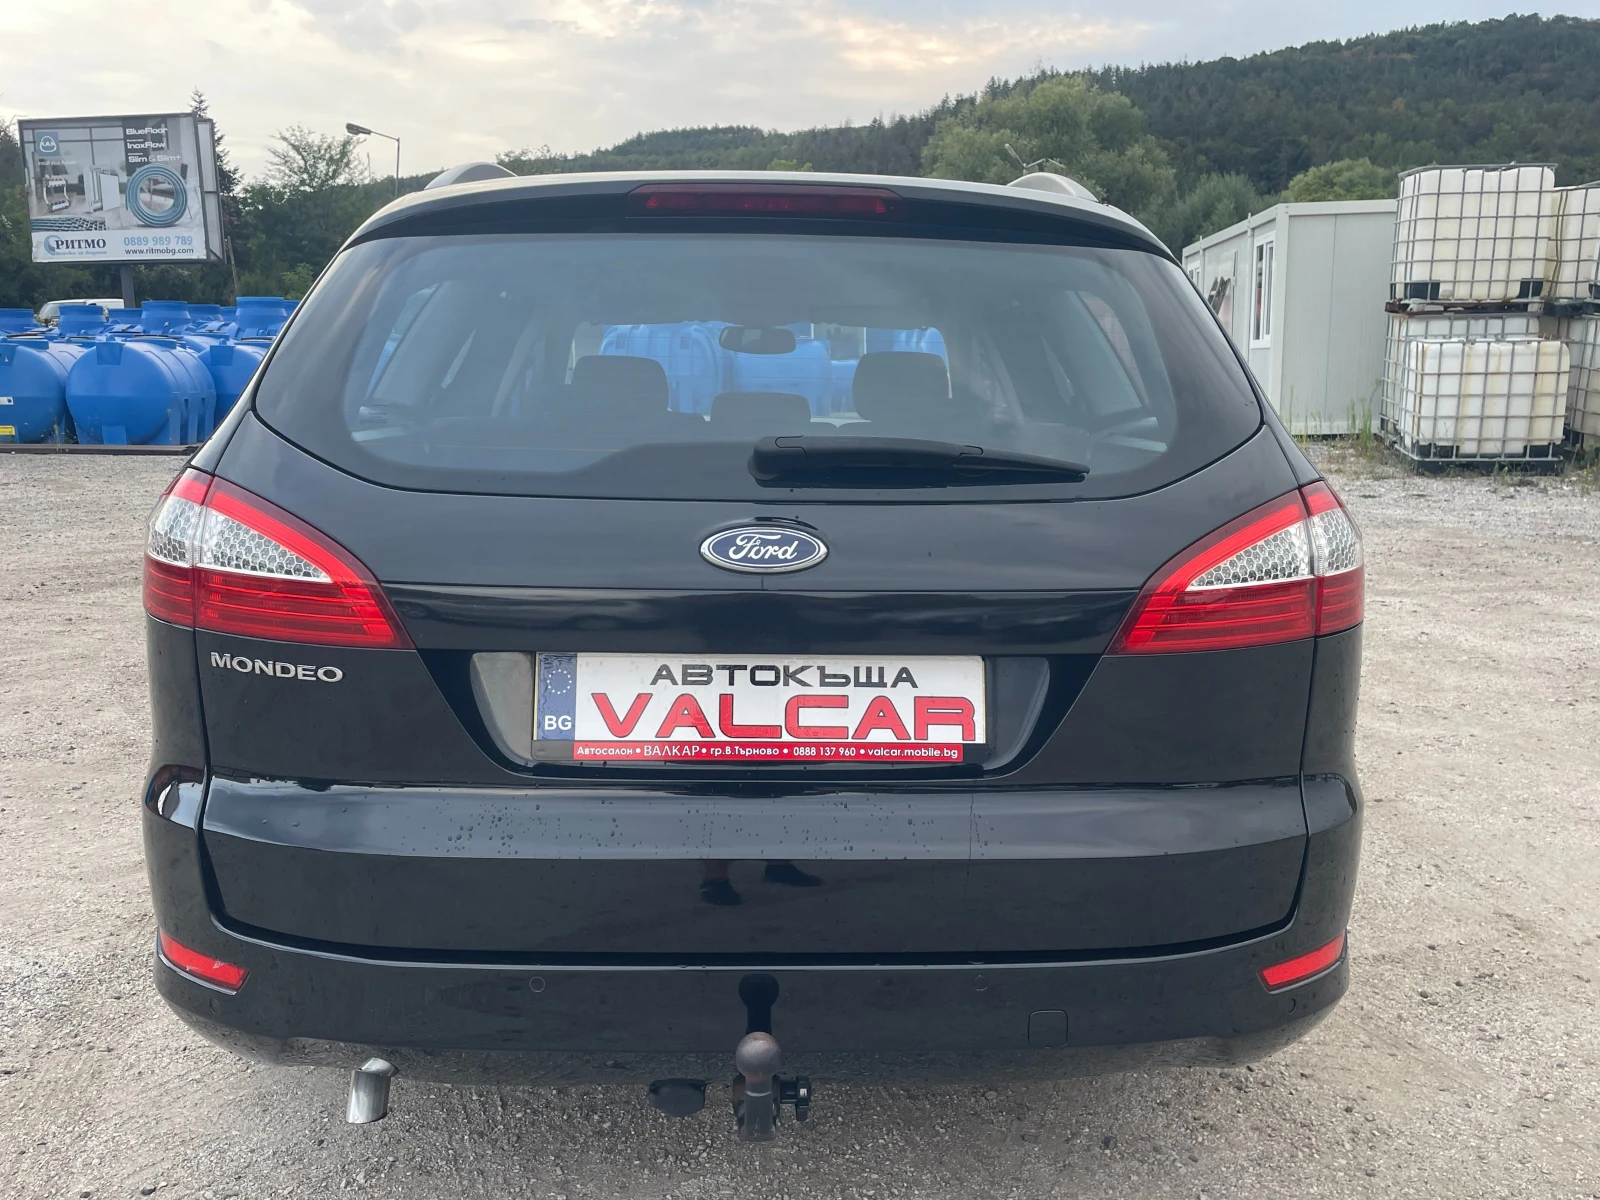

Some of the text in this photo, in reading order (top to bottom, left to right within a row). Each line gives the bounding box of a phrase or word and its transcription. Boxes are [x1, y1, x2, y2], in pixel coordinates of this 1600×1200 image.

[157, 154, 181, 162] Slim+
[55, 238, 107, 250] РИТМО
[124, 235, 193, 246] 0889 989 789
[728, 533, 799, 560] Ford
[210, 652, 343, 683] MONDEO
[650, 664, 919, 689] АВТОКЪЩА
[544, 715, 572, 731] BG
[591, 693, 976, 741] VALCAR
[576, 746, 633, 756] Автосалон
[643, 745, 700, 757] ВАЛКАР
[793, 747, 817, 757] 0888
[819, 747, 836, 757] 137
[838, 747, 856, 757] 960
[867, 747, 959, 758] valcar.mobile.bg
